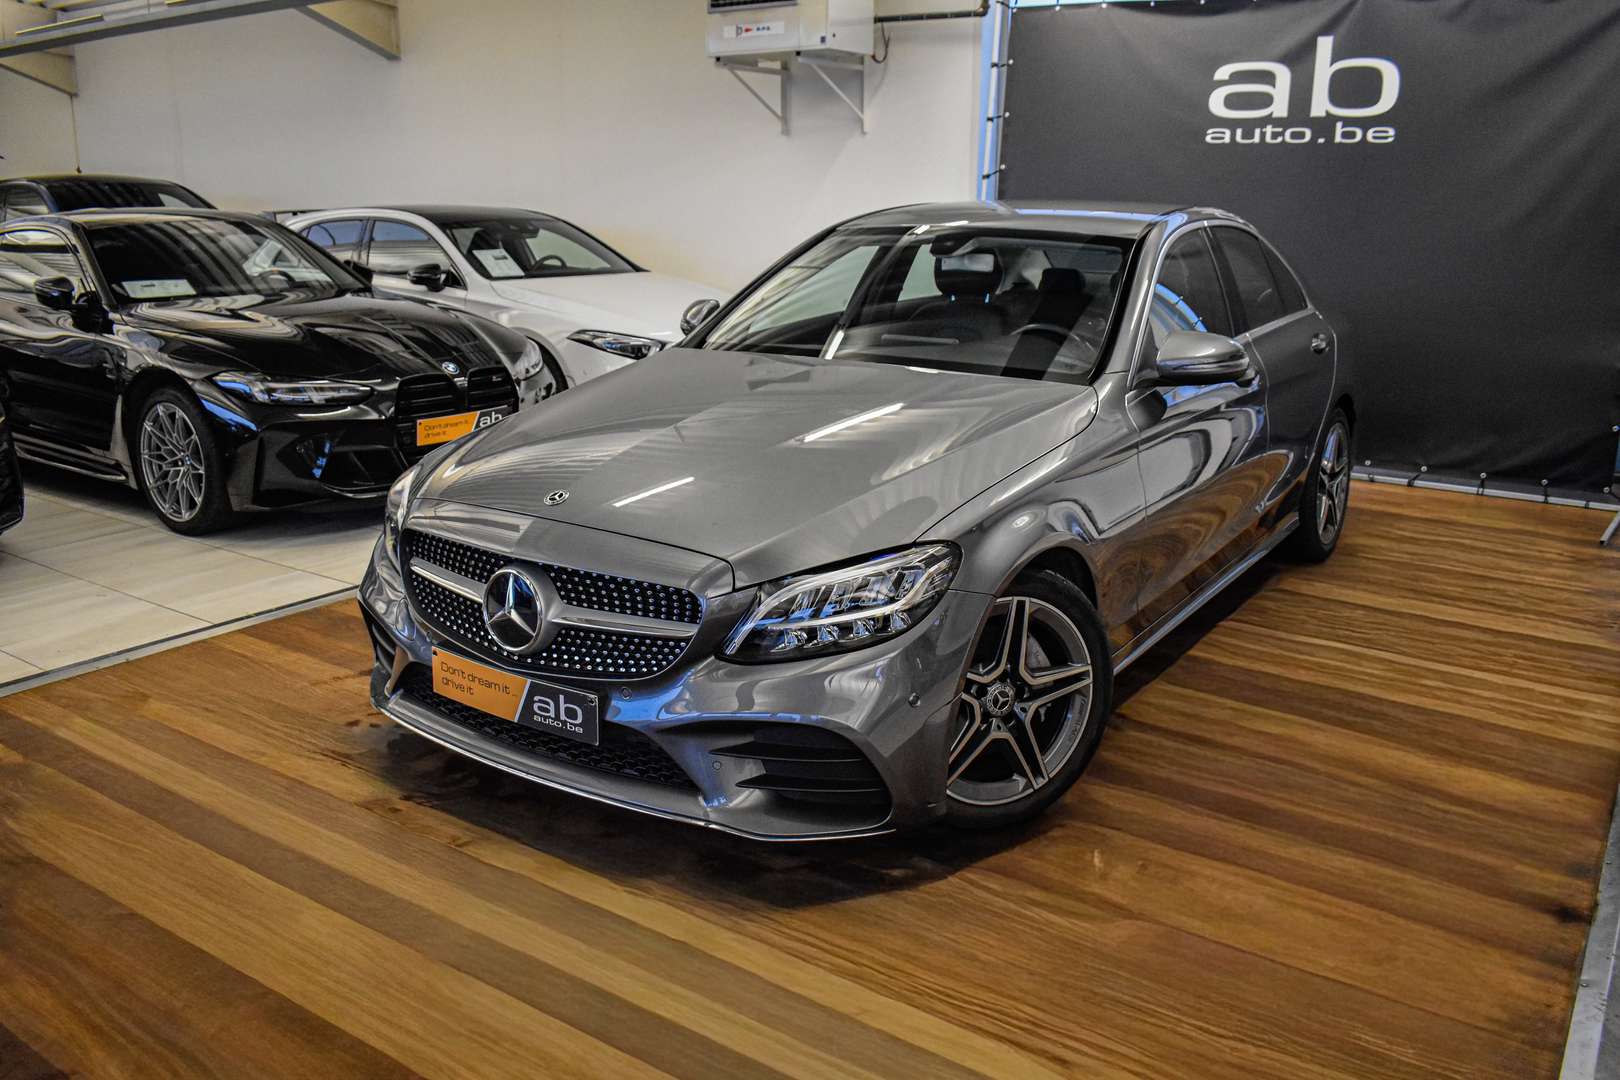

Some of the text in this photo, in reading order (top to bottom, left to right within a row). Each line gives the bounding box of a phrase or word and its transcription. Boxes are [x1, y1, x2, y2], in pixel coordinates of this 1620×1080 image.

[1207, 35, 1401, 119] ab
[1204, 121, 1396, 144] auto.be
[440, 661, 466, 679] Don't
[467, 672, 501, 692] dream
[441, 676, 474, 696] drive it
[533, 694, 583, 724] ab
[533, 714, 584, 734] auto.be
